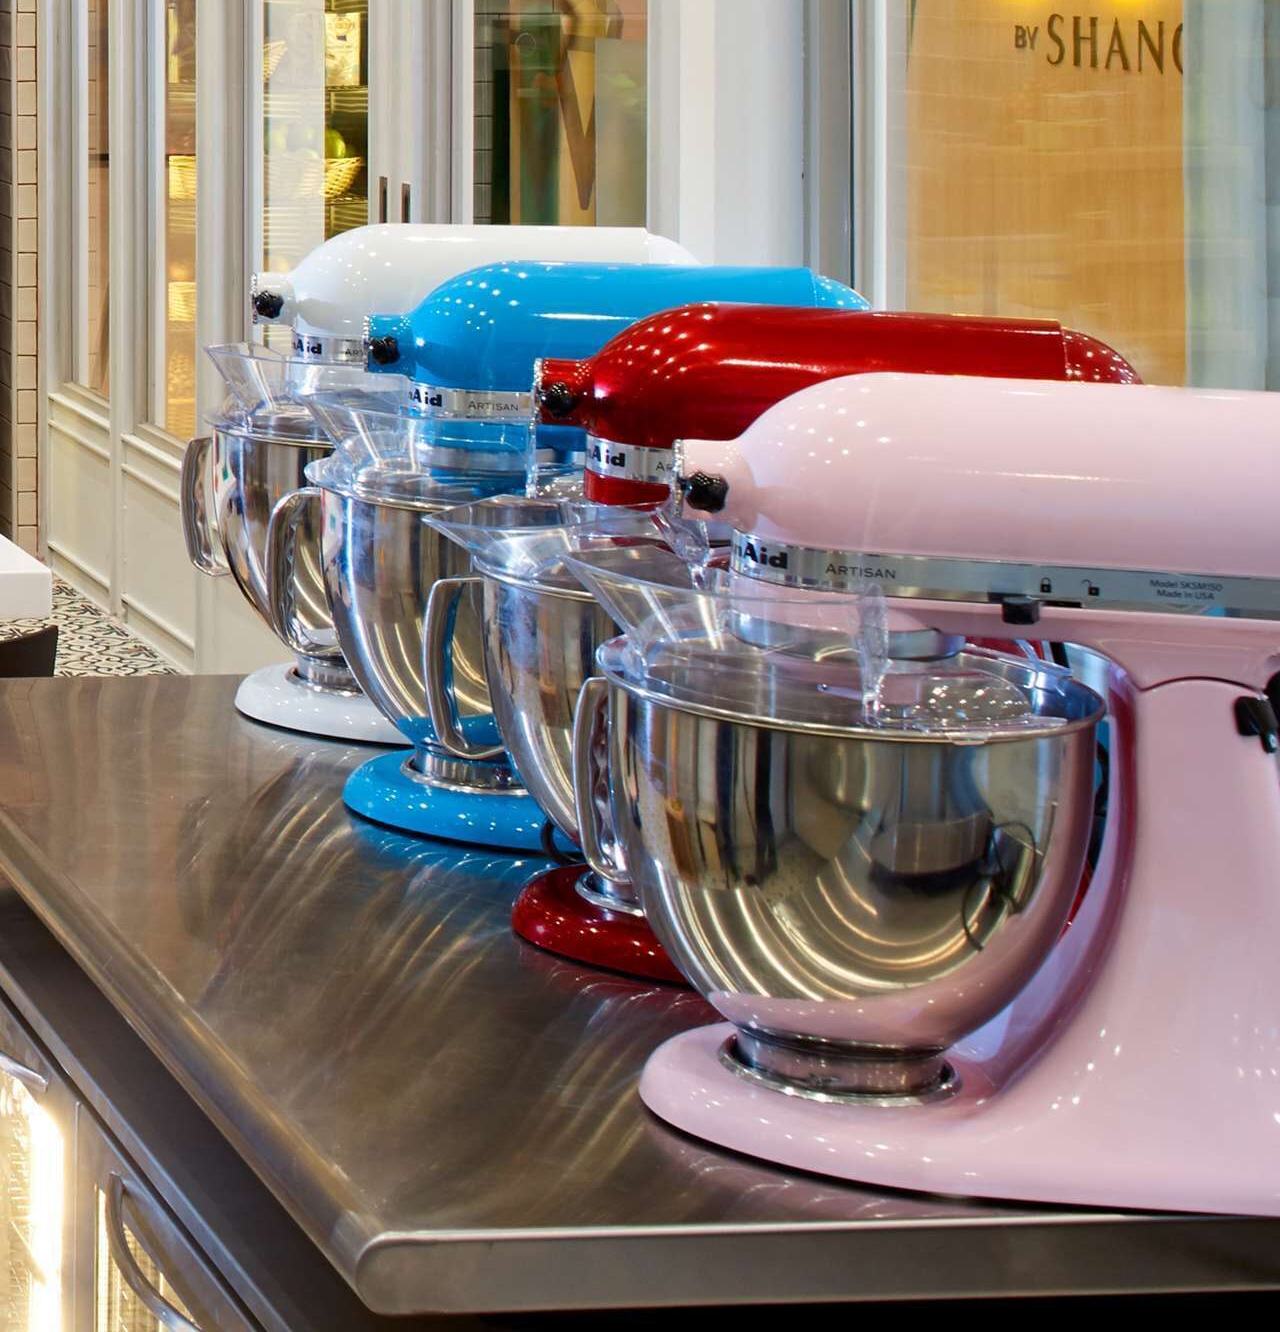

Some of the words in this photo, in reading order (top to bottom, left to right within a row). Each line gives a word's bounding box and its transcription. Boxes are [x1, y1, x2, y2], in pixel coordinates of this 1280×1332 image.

[1014, 24, 1039, 50] BY
[468, 400, 519, 412] ARTISAN
[825, 563, 896, 579] ARTISAN
[1150, 579, 1178, 588] Model
[1156, 589, 1181, 598] Made
[1195, 591, 1215, 600] USA
